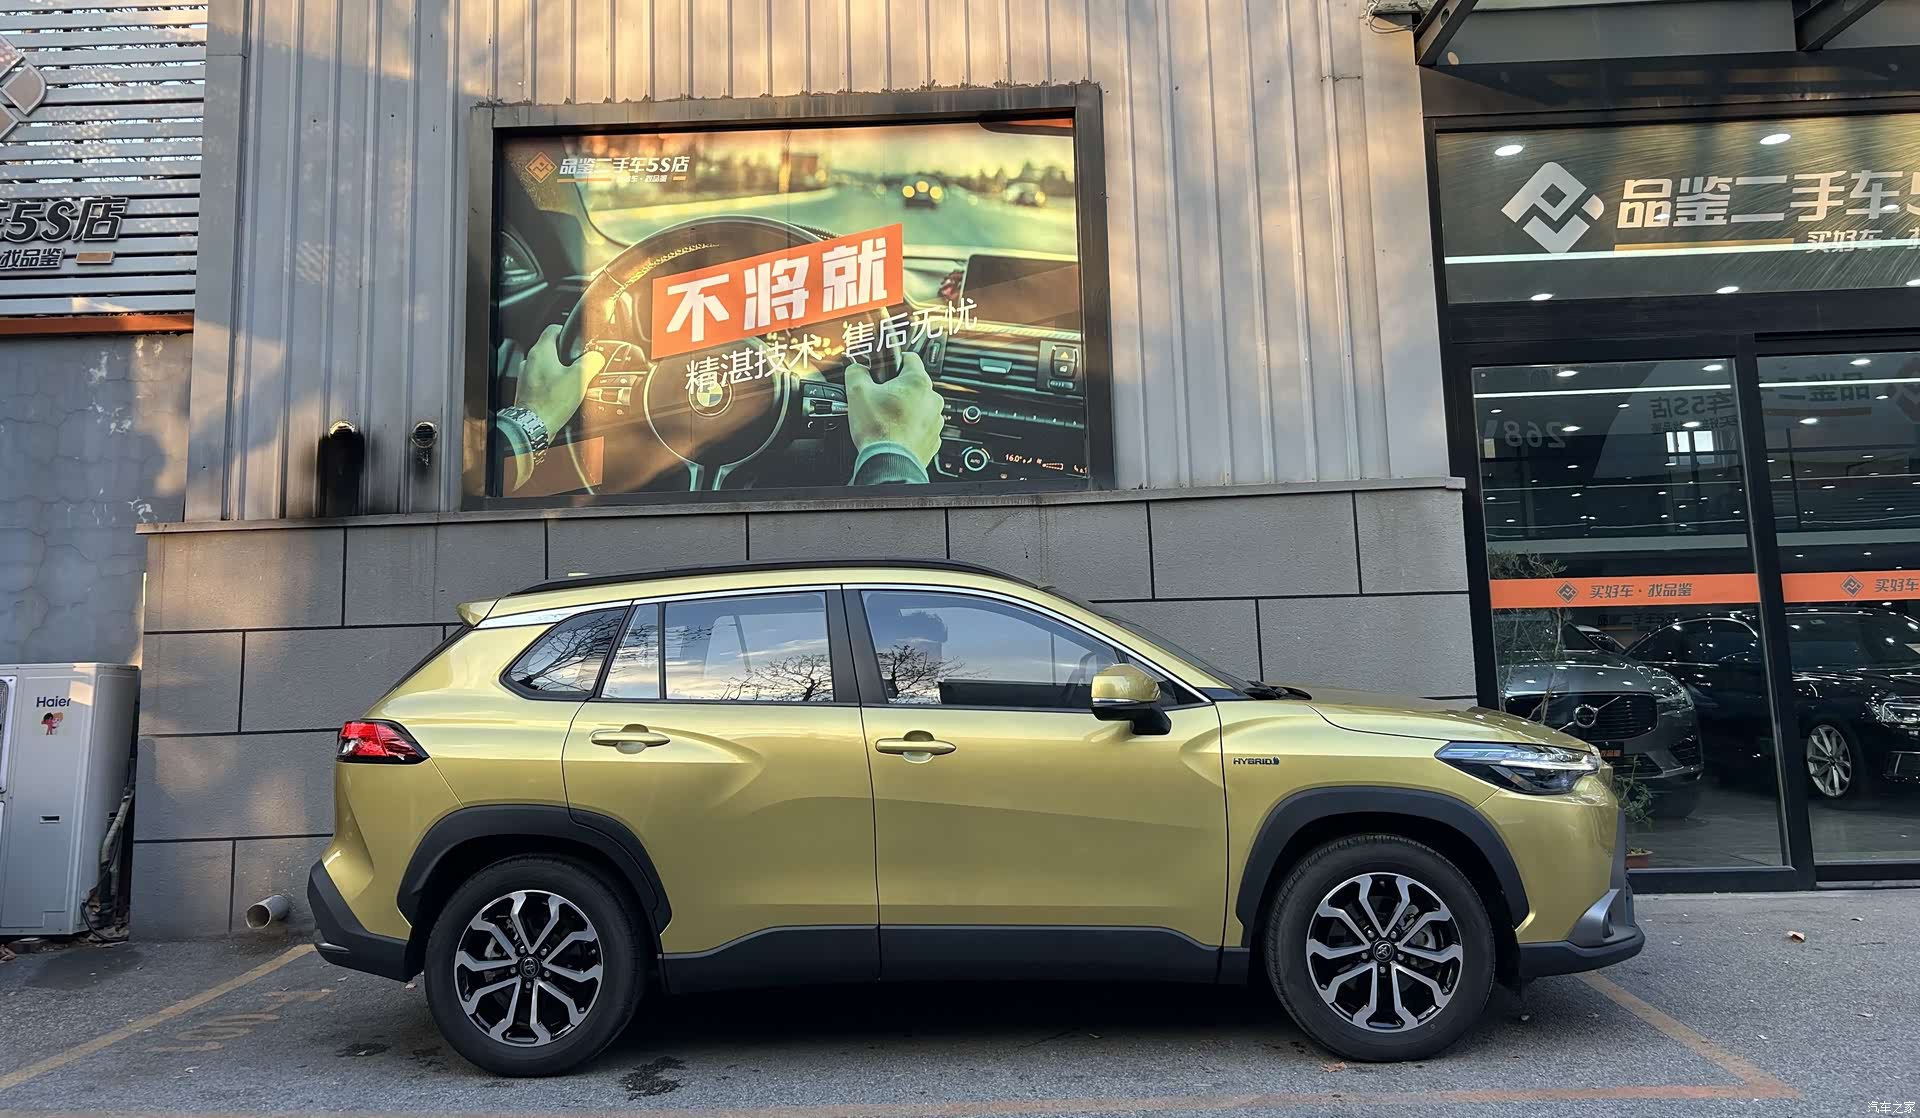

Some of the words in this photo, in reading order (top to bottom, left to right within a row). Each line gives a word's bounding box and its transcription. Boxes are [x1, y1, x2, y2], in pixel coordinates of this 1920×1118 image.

[559, 155, 691, 175] 品鉴二手车5S店
[0, 195, 129, 242] 5S店
[666, 235, 889, 343] 不将就
[684, 333, 824, 395] 精湛技术
[841, 297, 978, 359] 售后无忧
[36, 696, 72, 708] Haier
[1233, 757, 1273, 765] HYBRID
